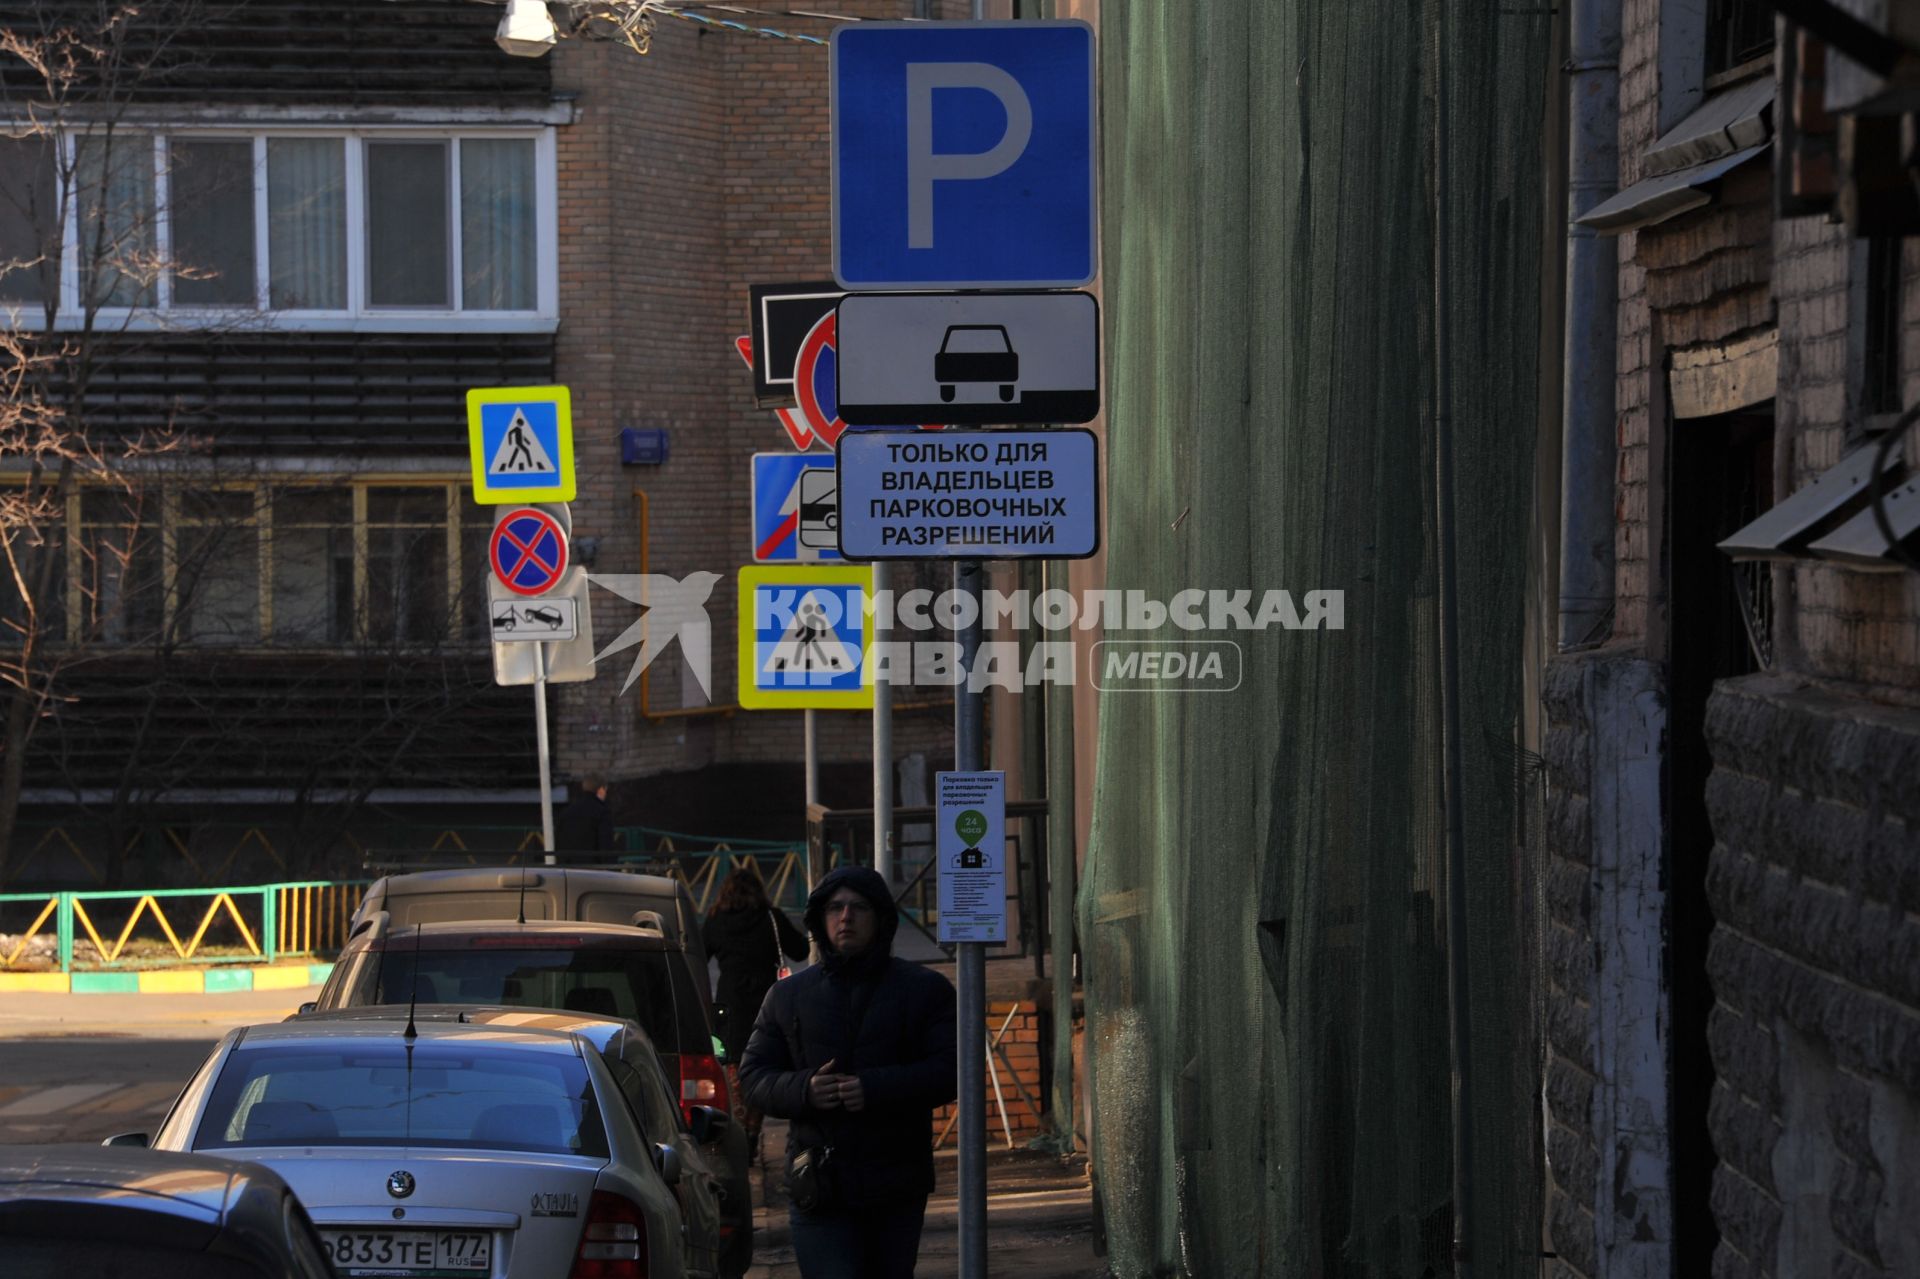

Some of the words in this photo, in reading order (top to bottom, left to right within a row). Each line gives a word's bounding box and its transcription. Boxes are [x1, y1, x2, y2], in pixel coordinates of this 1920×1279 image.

[906, 62, 1033, 249] P
[887, 443, 988, 463] ТОЛЬКО
[995, 442, 1047, 466] ДЛЯ
[881, 470, 1055, 494] ВЛАДЕЛЬЦЕВ
[869, 497, 1067, 518] ПАРКОВОЧНЫХ
[881, 521, 1055, 545] РАЗРЕШЕНИЙ
[965, 817, 977, 825] 24
[440, 1233, 482, 1257] 177
[447, 1257, 470, 1266] RUS
